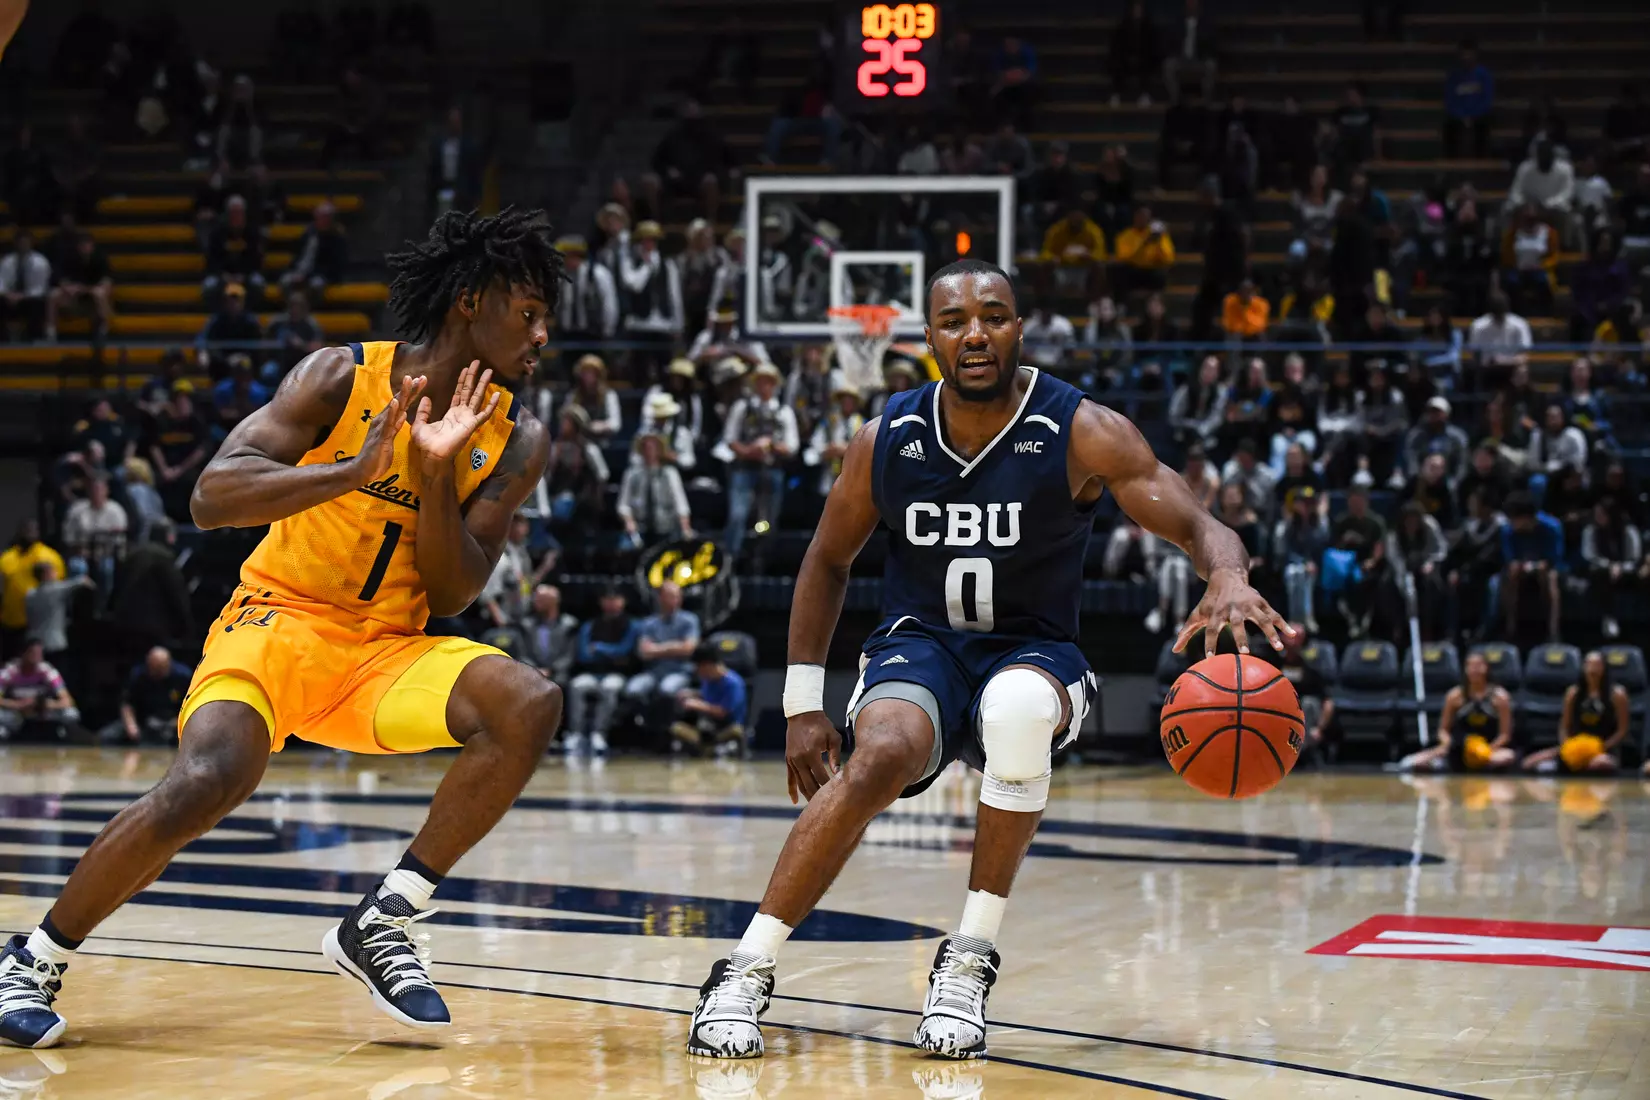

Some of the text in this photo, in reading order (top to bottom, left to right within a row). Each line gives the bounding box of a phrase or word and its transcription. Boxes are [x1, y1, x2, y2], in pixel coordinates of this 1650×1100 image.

[861, 3, 936, 39] 10:03
[857, 38, 926, 97] 25
[900, 448, 926, 462] adidas
[1014, 441, 1044, 454] WAC
[905, 502, 1022, 546] CBU
[357, 520, 403, 602] 1
[945, 557, 994, 633] 0
[995, 782, 1029, 795] adidas
